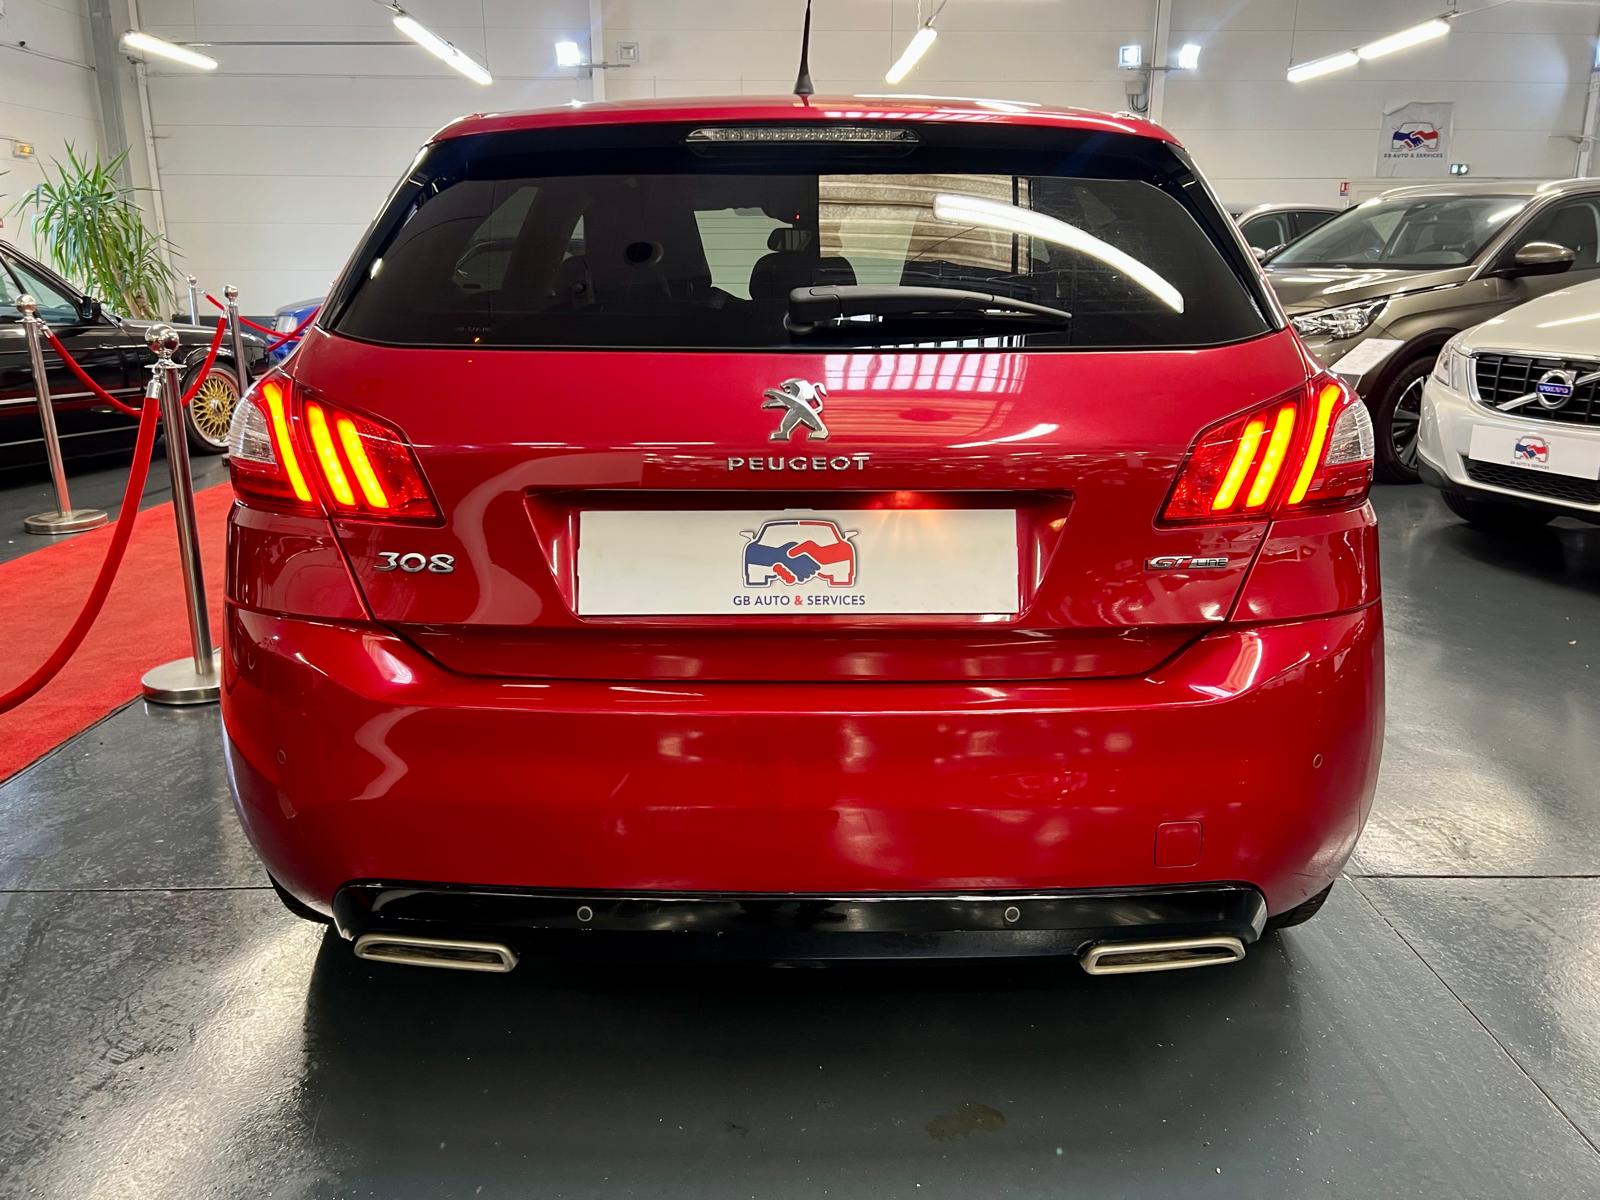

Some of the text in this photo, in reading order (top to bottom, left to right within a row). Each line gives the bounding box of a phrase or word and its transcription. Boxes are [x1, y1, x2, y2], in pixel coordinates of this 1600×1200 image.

[1539, 385, 1569, 394] VOLVO
[727, 456, 870, 471] PEUGEOT
[373, 551, 455, 573] 308
[1150, 555, 1193, 569] GT
[733, 595, 866, 606] GB AUTO & SERVICES
